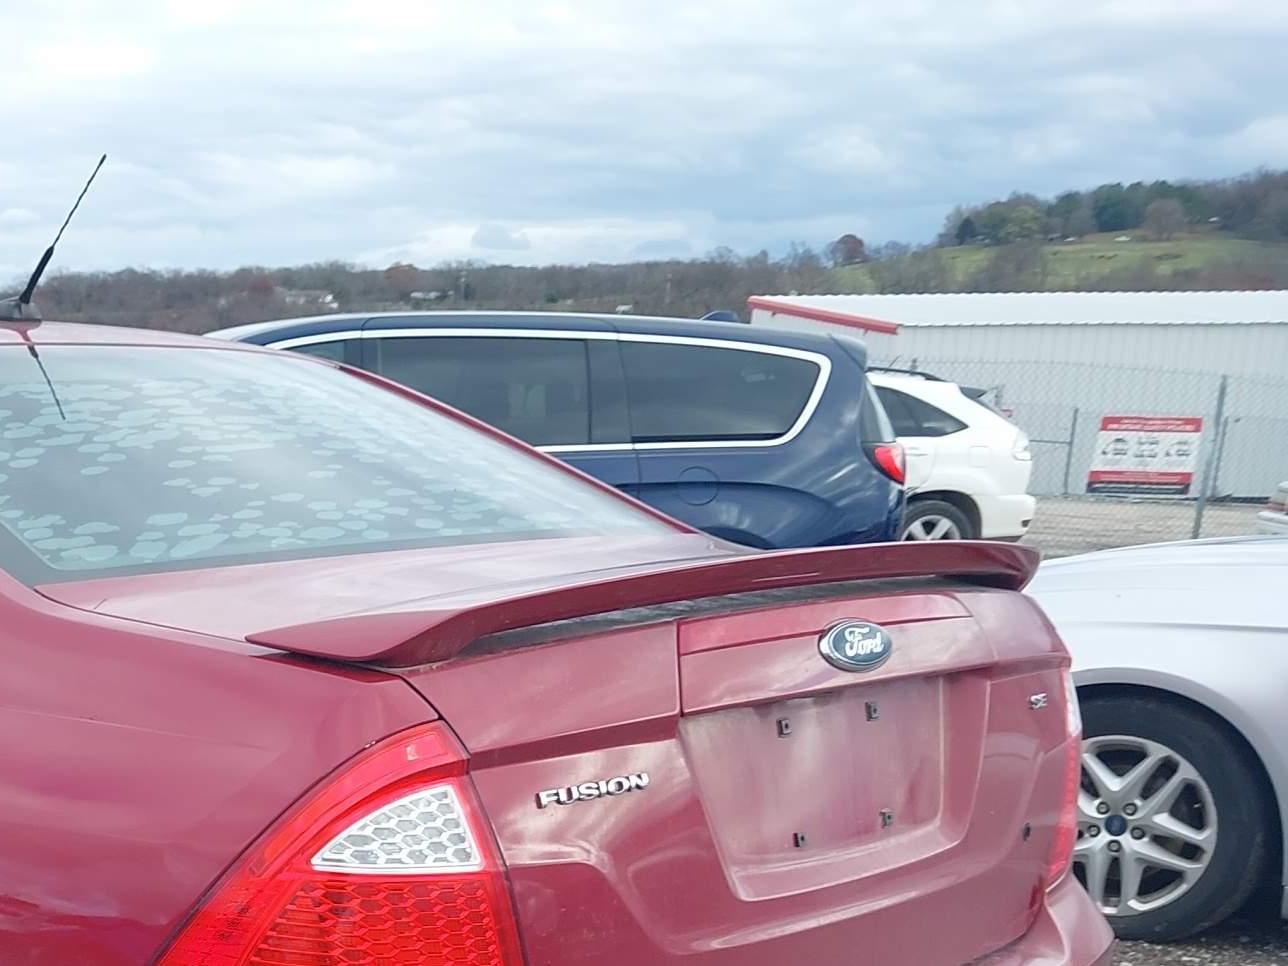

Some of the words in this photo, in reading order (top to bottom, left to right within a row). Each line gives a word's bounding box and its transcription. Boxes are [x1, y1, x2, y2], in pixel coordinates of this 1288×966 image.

[844, 627, 884, 657] Ford
[1030, 692, 1047, 709] SE
[536, 772, 650, 809] FUSION
